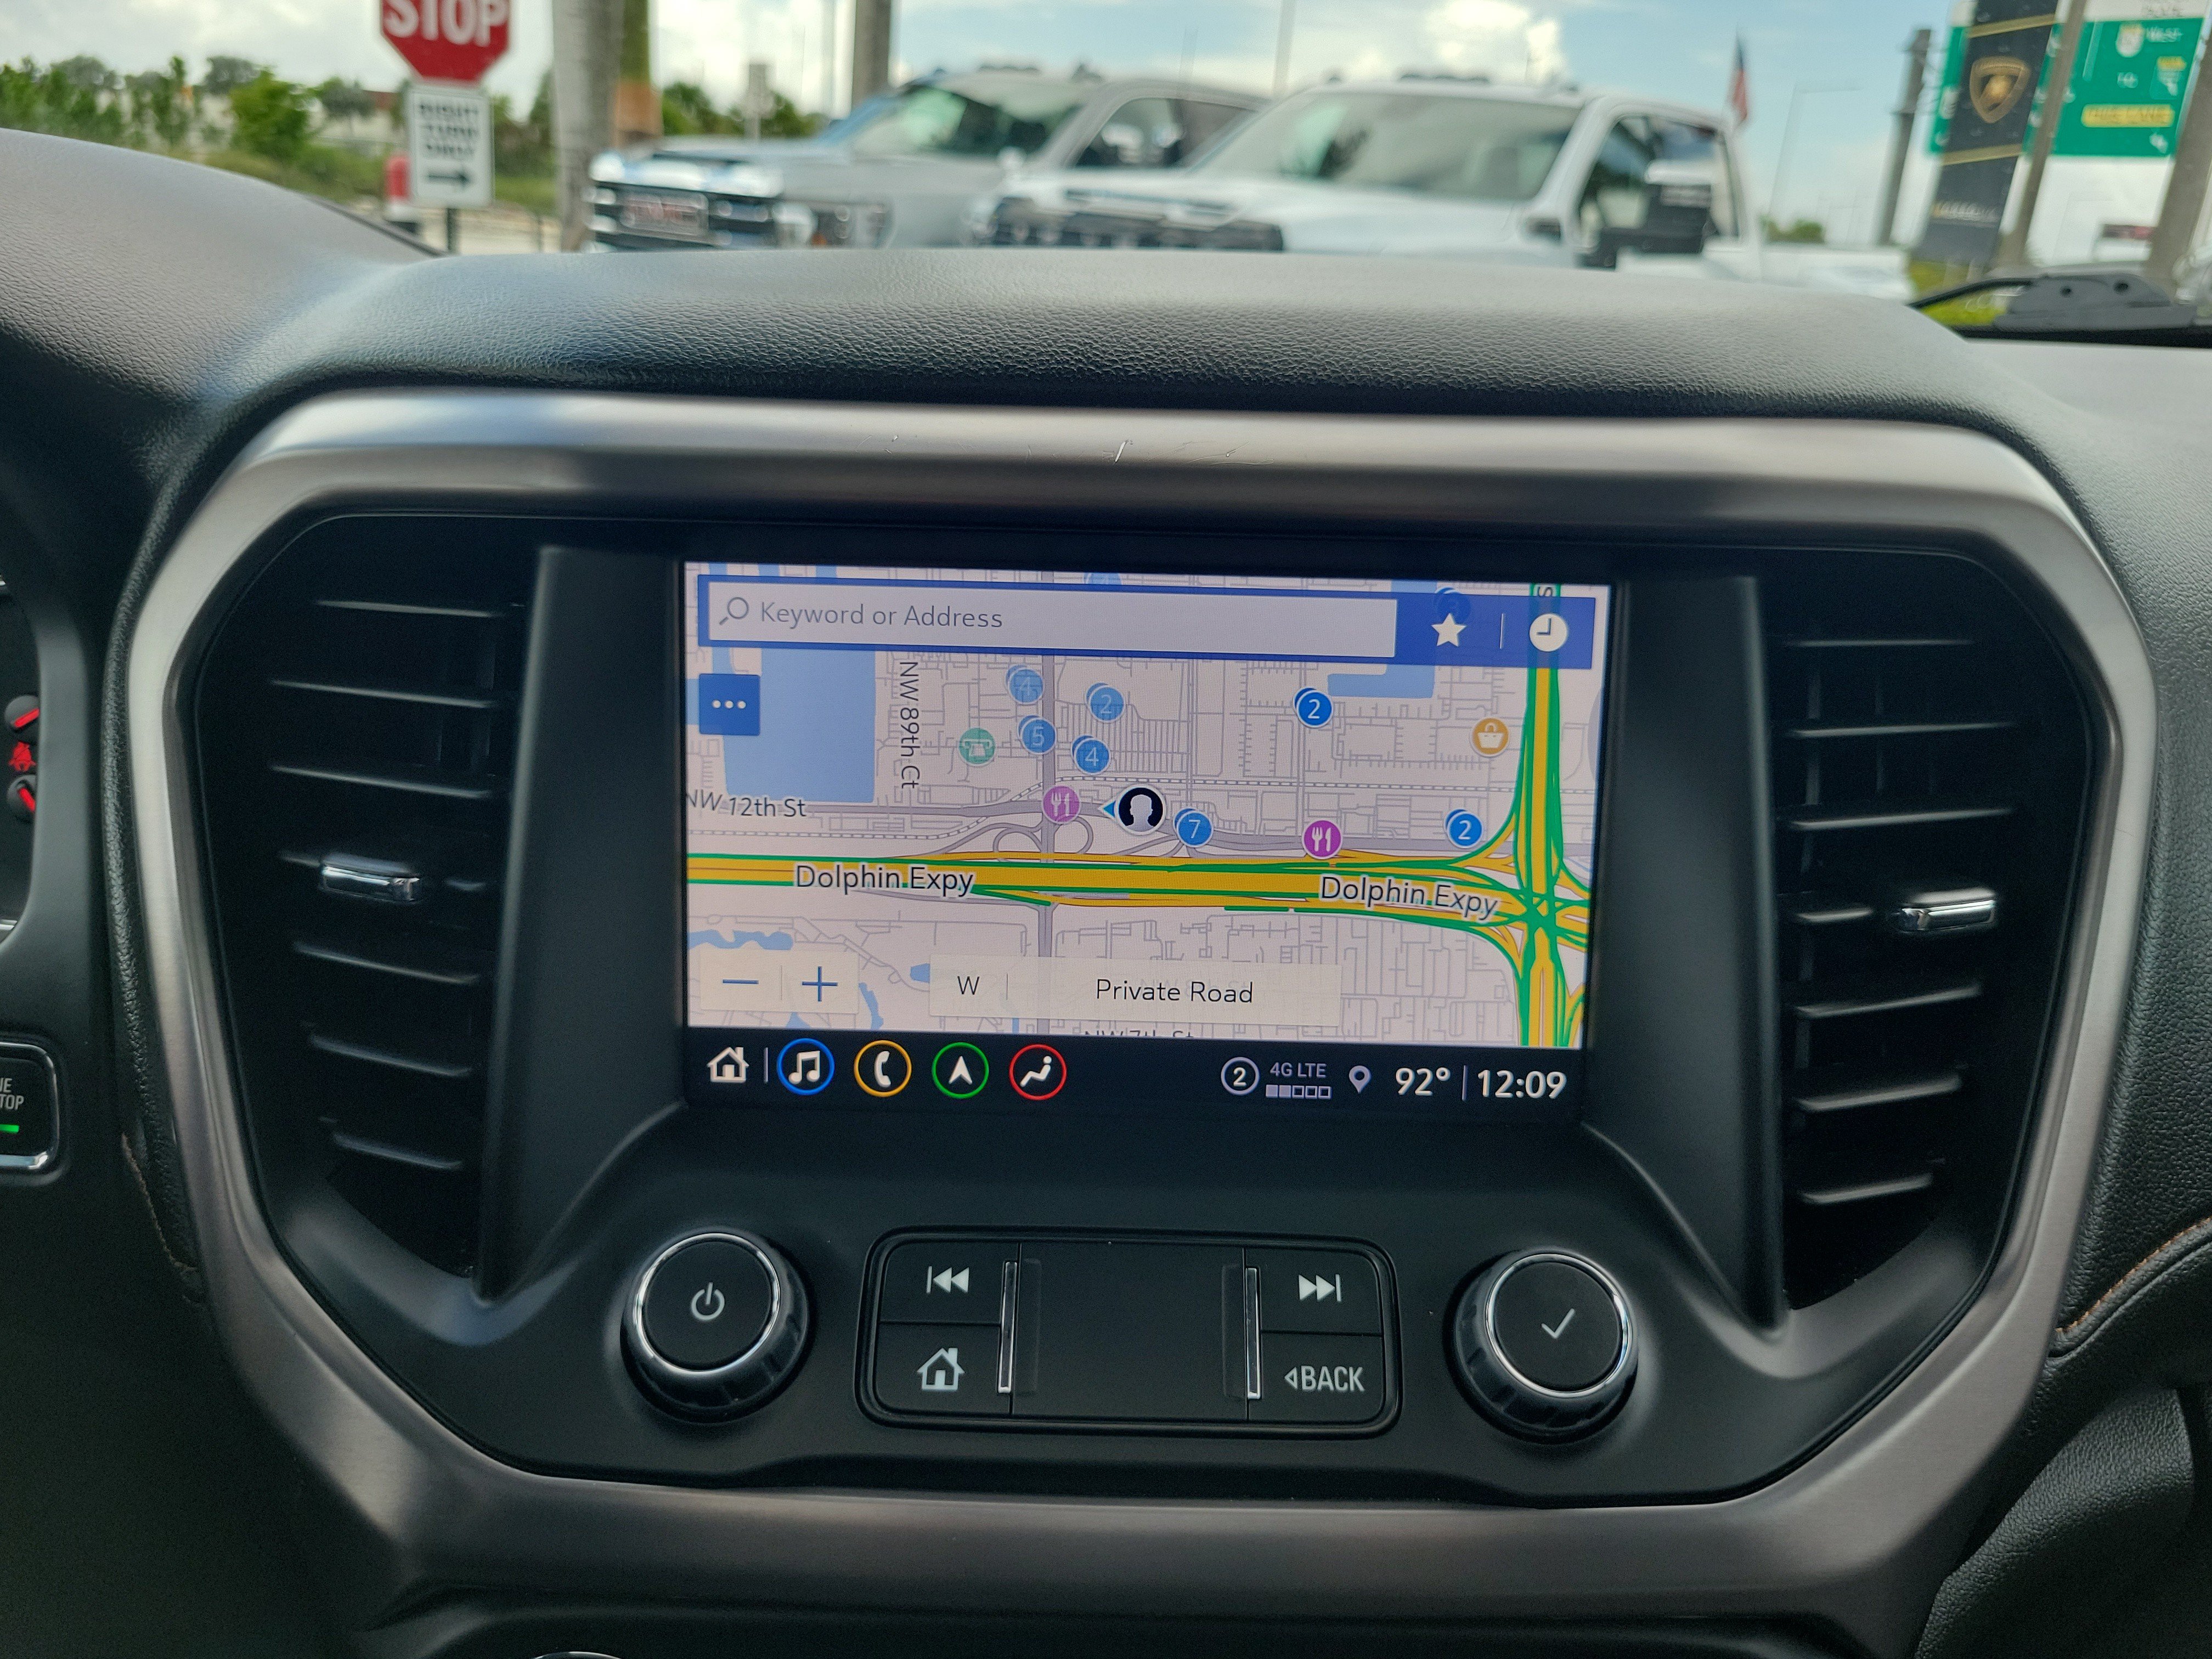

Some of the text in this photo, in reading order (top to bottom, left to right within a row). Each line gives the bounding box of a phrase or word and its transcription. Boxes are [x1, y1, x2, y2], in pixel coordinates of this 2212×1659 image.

[383, 0, 510, 47] STOP
[761, 601, 1002, 629] Keyword or Address
[1100, 694, 1113, 714] 2
[1307, 698, 1321, 719] 2
[899, 662, 921, 789] NW 89th Ct
[1085, 747, 1099, 766] 4
[687, 789, 806, 817] NW 12th St
[1188, 819, 1201, 839] 7
[1458, 820, 1471, 840] 2
[797, 865, 974, 897] Dolphin Expy
[1321, 876, 1498, 921] Dolphin Expy
[957, 975, 980, 995] W
[1097, 979, 1252, 1003] Private Road
[1233, 1066, 1247, 1087] 2
[1270, 1062, 1327, 1079] 4G LTE
[1477, 1069, 1567, 1099] 12:09
[1301, 1365, 1364, 1392] BACK
